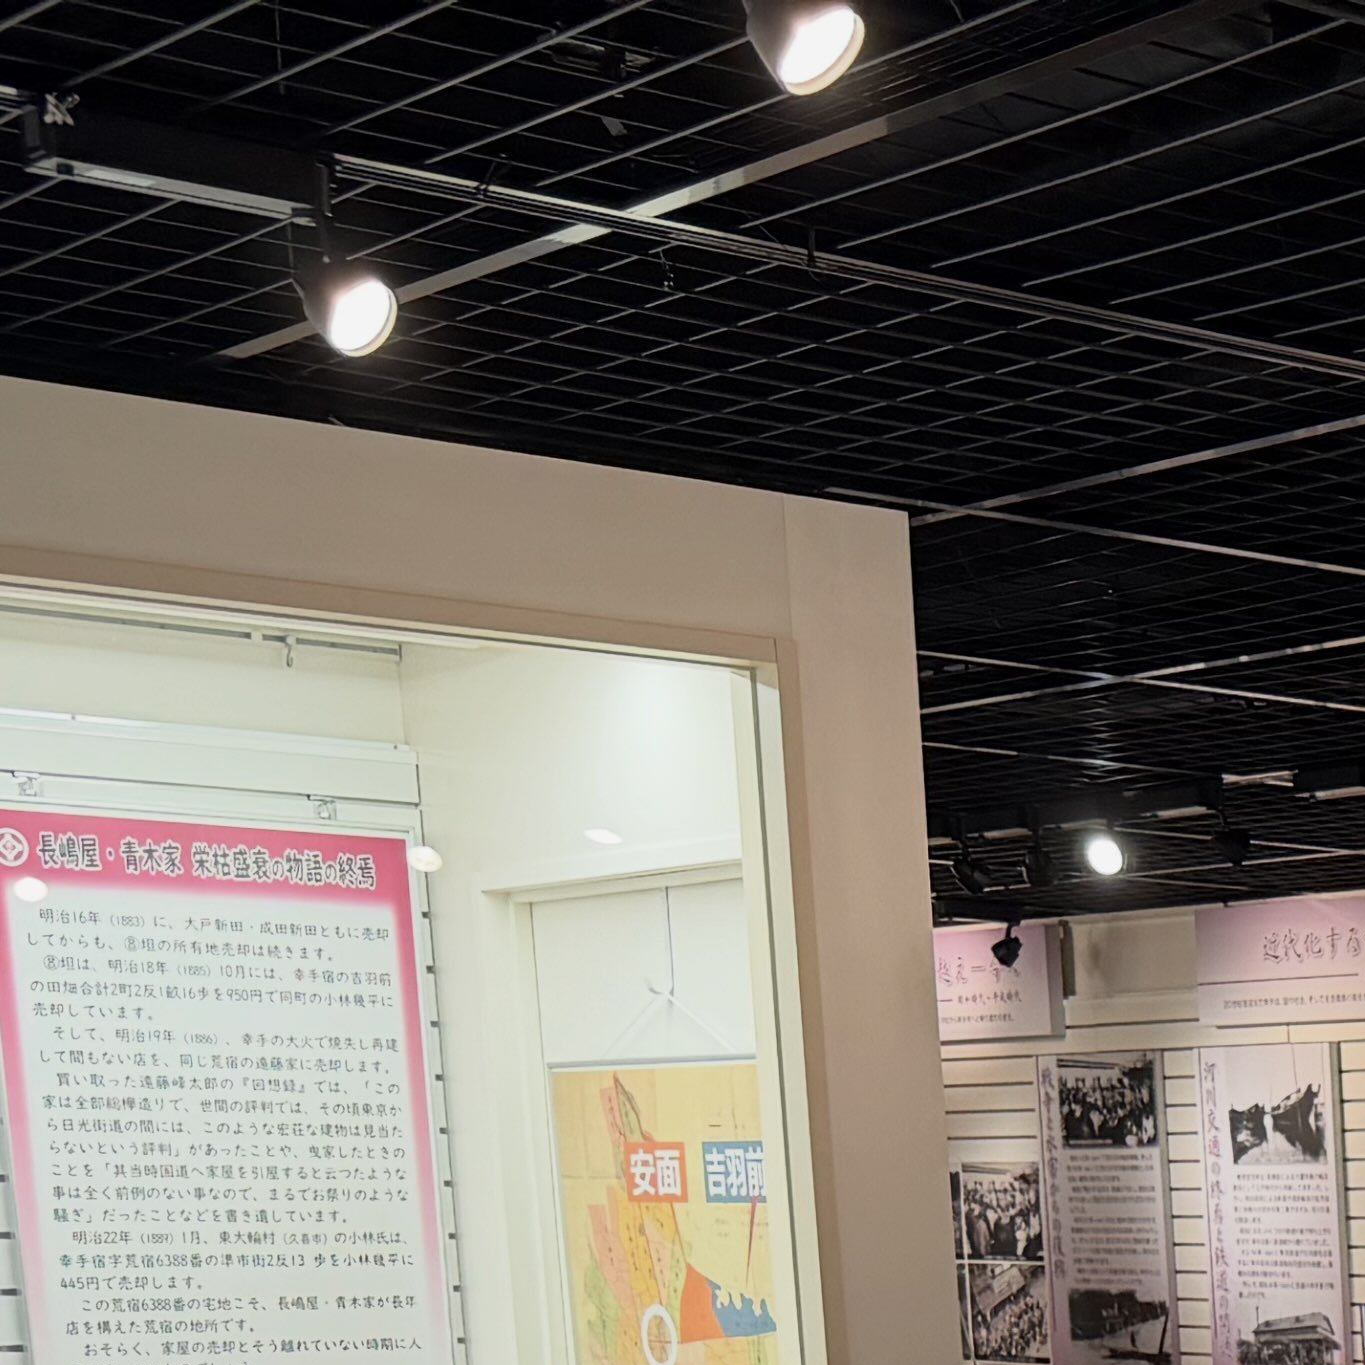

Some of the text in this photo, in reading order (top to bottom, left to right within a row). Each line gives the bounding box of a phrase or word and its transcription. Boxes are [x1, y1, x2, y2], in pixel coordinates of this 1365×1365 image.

[39, 833, 377, 890] 長嶋屋・青木家 栄枯盛衰の物語の終焉
[629, 1148, 682, 1198] 安面
